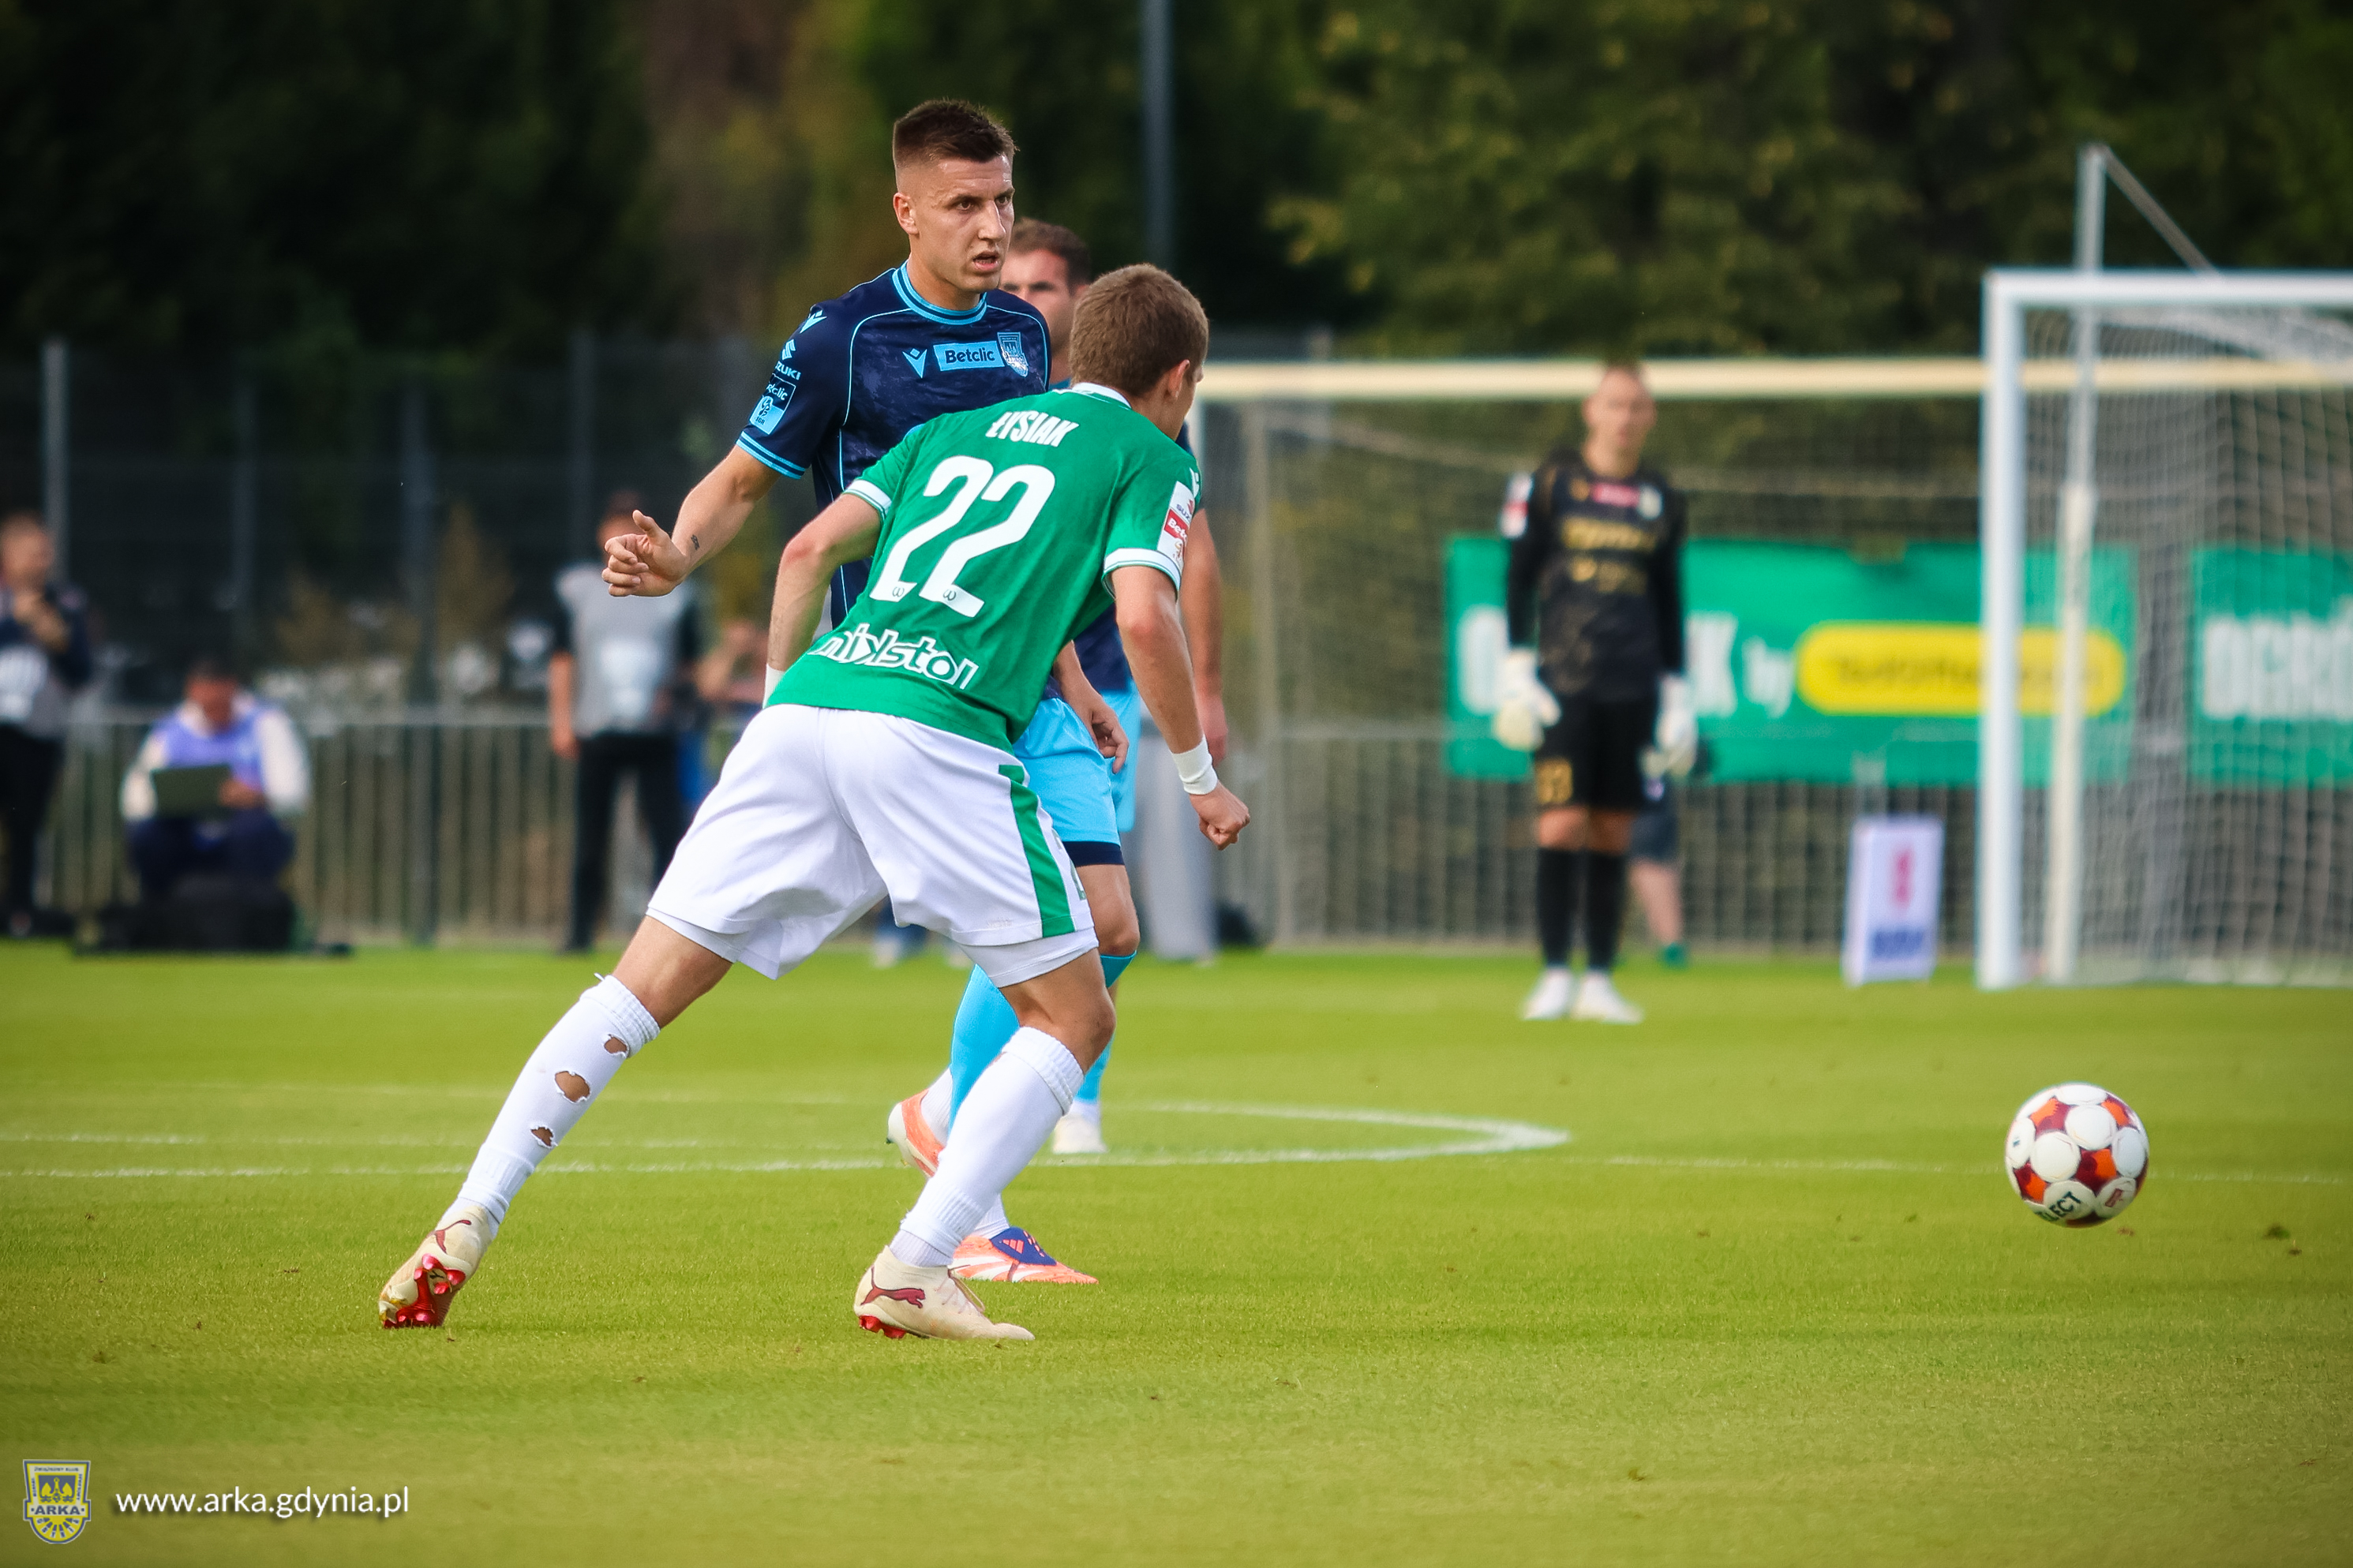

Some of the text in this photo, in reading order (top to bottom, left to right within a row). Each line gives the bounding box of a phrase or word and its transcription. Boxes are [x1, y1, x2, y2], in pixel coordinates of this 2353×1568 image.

[944, 349, 995, 364] Betclic
[984, 410, 1080, 447] ŁYSIAK
[869, 455, 1055, 618] 22
